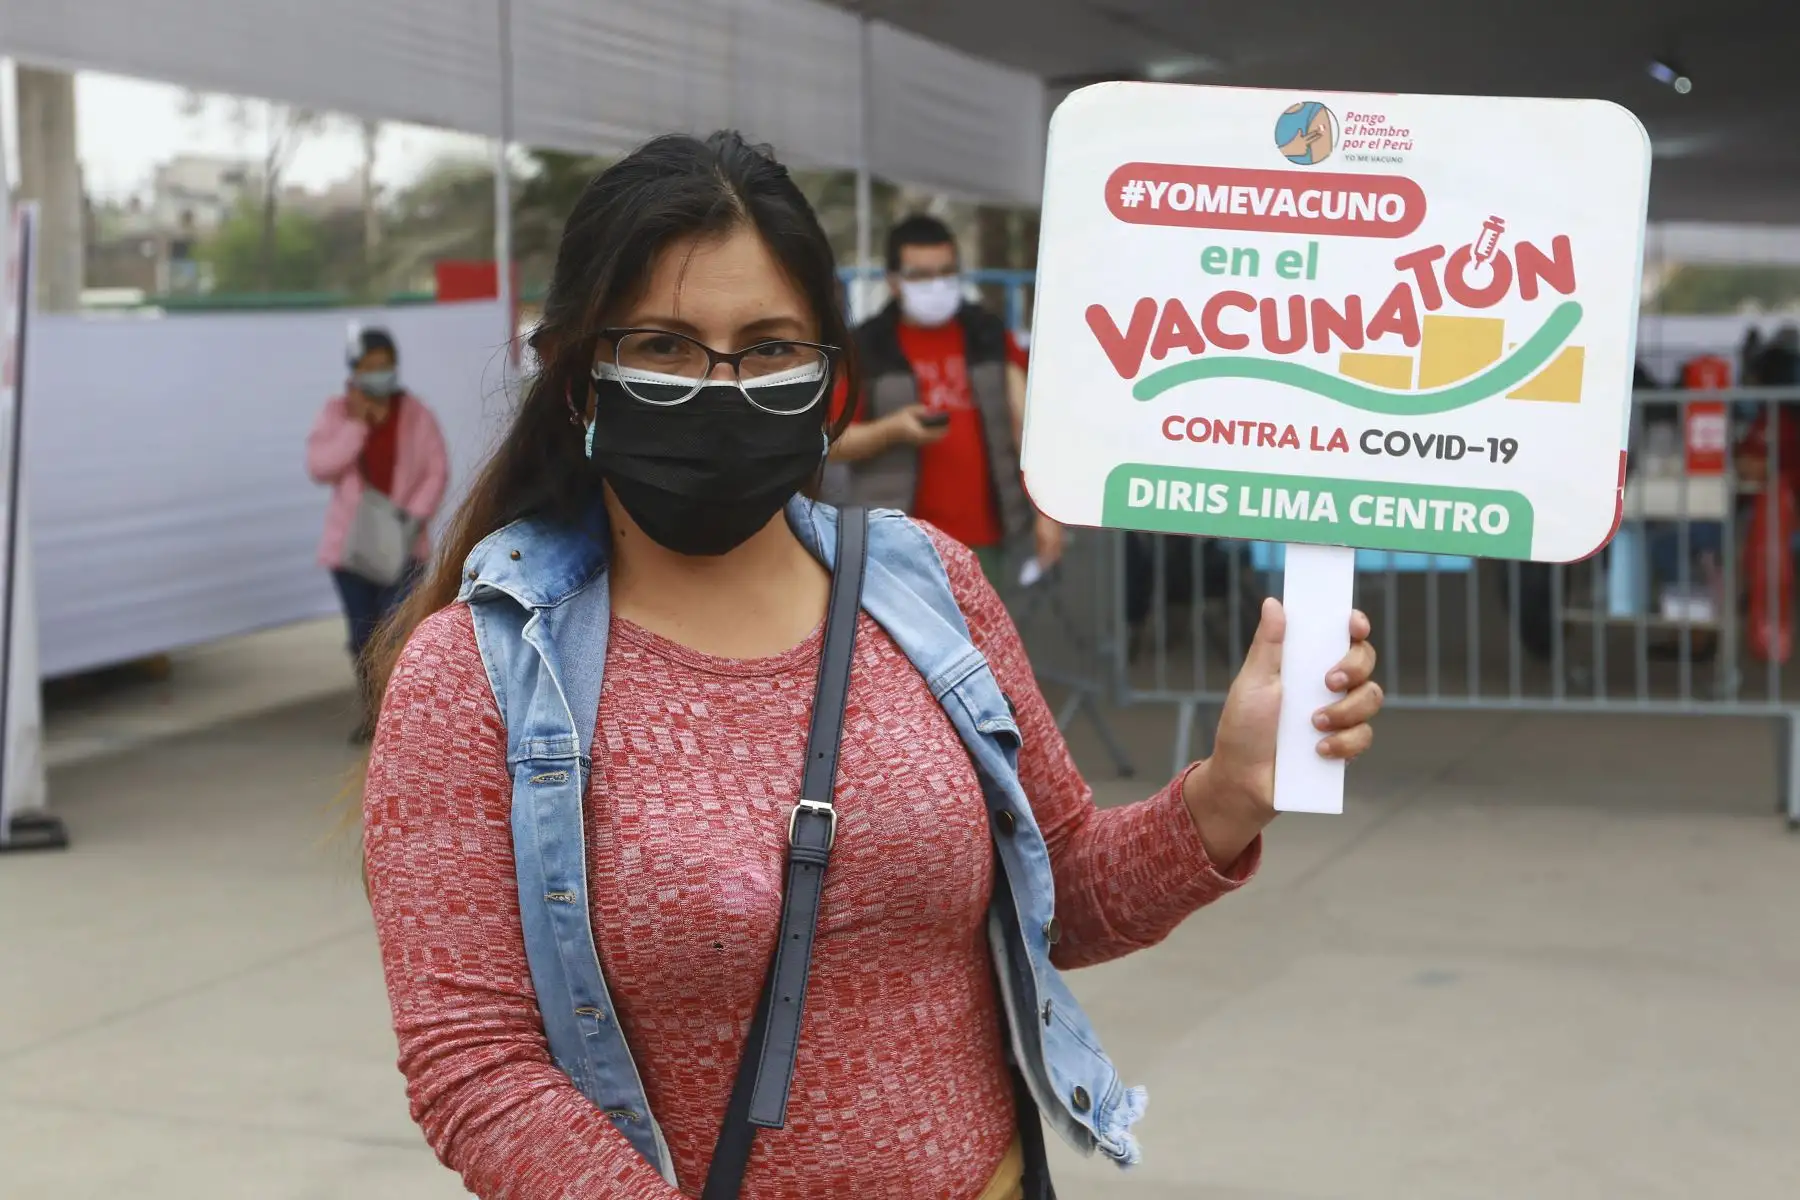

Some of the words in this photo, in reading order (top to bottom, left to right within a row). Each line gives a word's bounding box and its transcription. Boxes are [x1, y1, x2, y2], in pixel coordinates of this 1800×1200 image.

[1344, 125, 1356, 135] el
[1359, 126, 1410, 137] hombro
[1345, 111, 1386, 125] Pongo
[1342, 140, 1366, 151] por
[1368, 138, 1381, 149] el
[1383, 139, 1414, 151] Perú
[1120, 179, 1406, 223] #YOMEVACUNO
[1200, 246, 1260, 276] en
[1275, 242, 1319, 280] el
[1161, 415, 1300, 450] CONTRA
[1310, 427, 1350, 453] LA
[1359, 429, 1519, 464] COVID-19
[1128, 477, 1230, 514] DIRIS
[1238, 486, 1338, 524] LIMA
[1349, 493, 1511, 535] CENTRO
